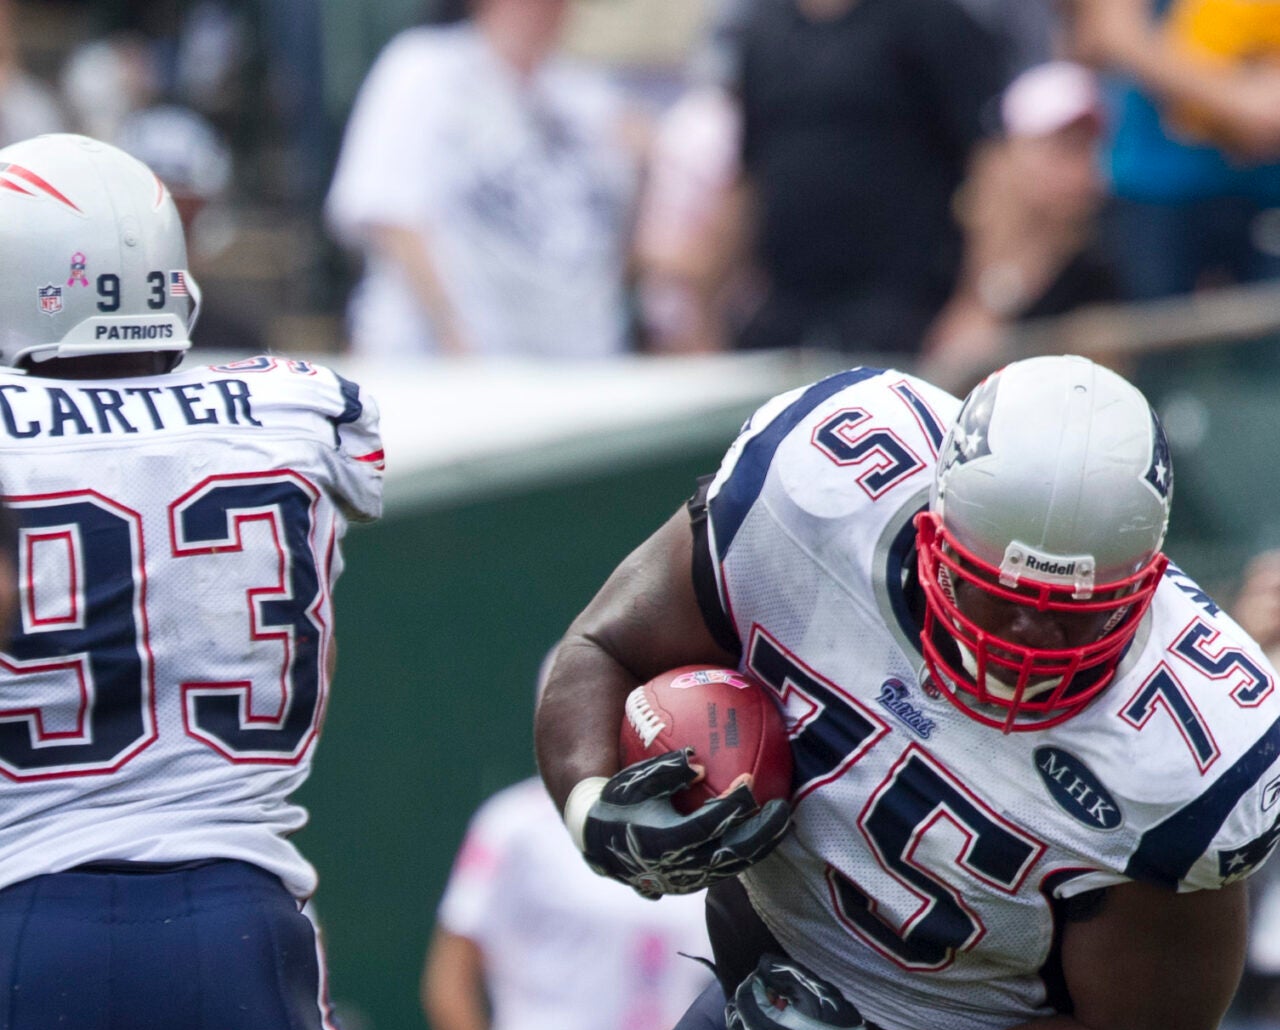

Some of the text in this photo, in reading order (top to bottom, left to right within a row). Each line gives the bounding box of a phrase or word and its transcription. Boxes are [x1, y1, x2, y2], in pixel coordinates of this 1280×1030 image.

[95, 324, 173, 340] PATRIOTS
[0, 379, 263, 440] CARTER
[1024, 554, 1076, 577] Riddell
[0, 469, 329, 784] 93
[1117, 615, 1275, 777] 75
[747, 622, 1049, 973] 75
